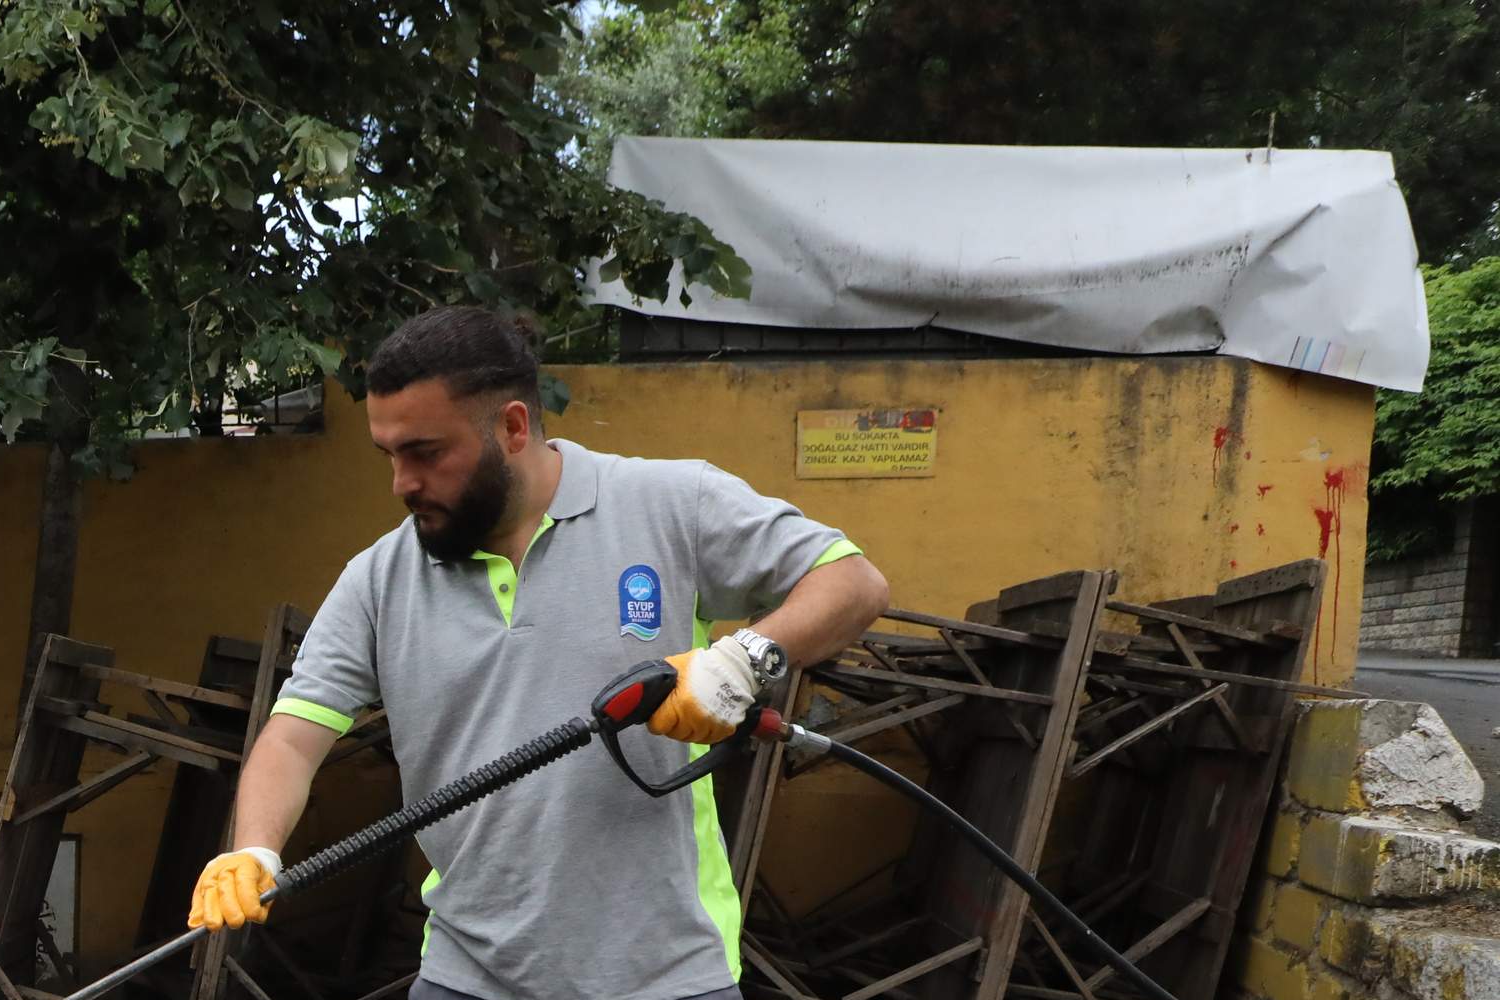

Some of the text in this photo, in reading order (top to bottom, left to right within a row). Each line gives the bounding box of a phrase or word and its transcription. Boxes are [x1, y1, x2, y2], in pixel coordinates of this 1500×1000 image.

[835, 431, 900, 441] BU SOKAKTA
[861, 442, 888, 451] HATTI
[891, 442, 929, 451] VARDIR
[842, 454, 866, 463] KAZI
[871, 453, 929, 462] YAPILAMAZ
[627, 610, 655, 618] SULTAN
